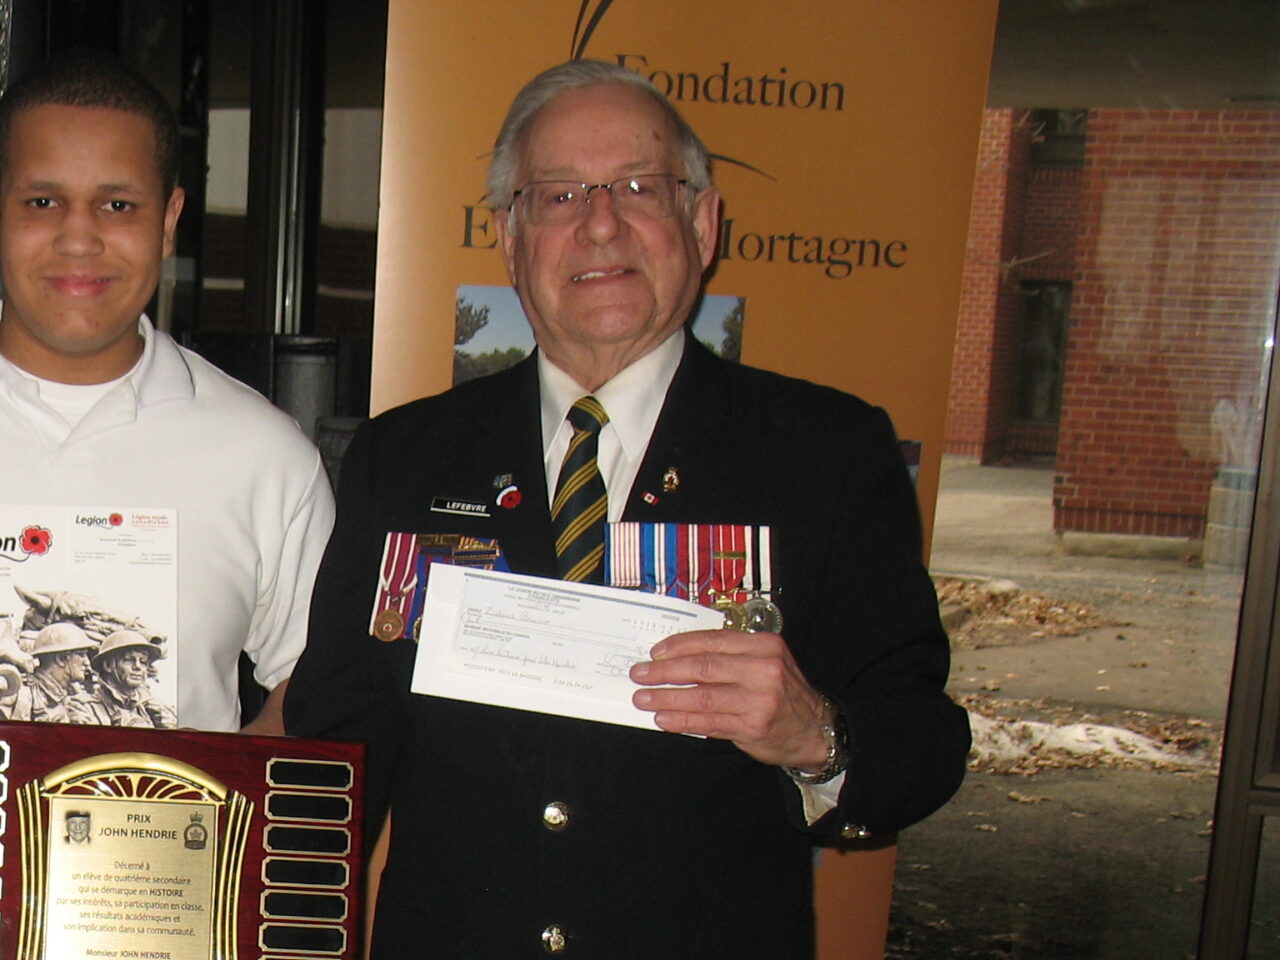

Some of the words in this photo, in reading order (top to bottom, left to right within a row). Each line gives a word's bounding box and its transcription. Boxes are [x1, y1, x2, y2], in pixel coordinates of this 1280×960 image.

[75, 514, 108, 527] Legion
[127, 813, 152, 824] PRIX
[98, 827, 128, 837] JOHN
[130, 828, 178, 840] HENDRIE
[114, 860, 145, 870] Décerné
[103, 873, 113, 882] de
[114, 874, 152, 885] quatrième
[152, 875, 192, 886] secondaire
[78, 885, 90, 894] qui
[101, 885, 138, 897] démarque
[149, 888, 184, 898] HISTOIRE
[123, 900, 170, 911] participation
[92, 911, 124, 921] résultats
[125, 911, 172, 924] académiques
[173, 914, 181, 923] et
[78, 922, 117, 933] implication
[118, 924, 136, 934] dans
[137, 926, 145, 934] sa
[86, 948, 118, 958] Monsieur
[120, 950, 139, 959] JOHN
[140, 951, 171, 960] HENDRIE
